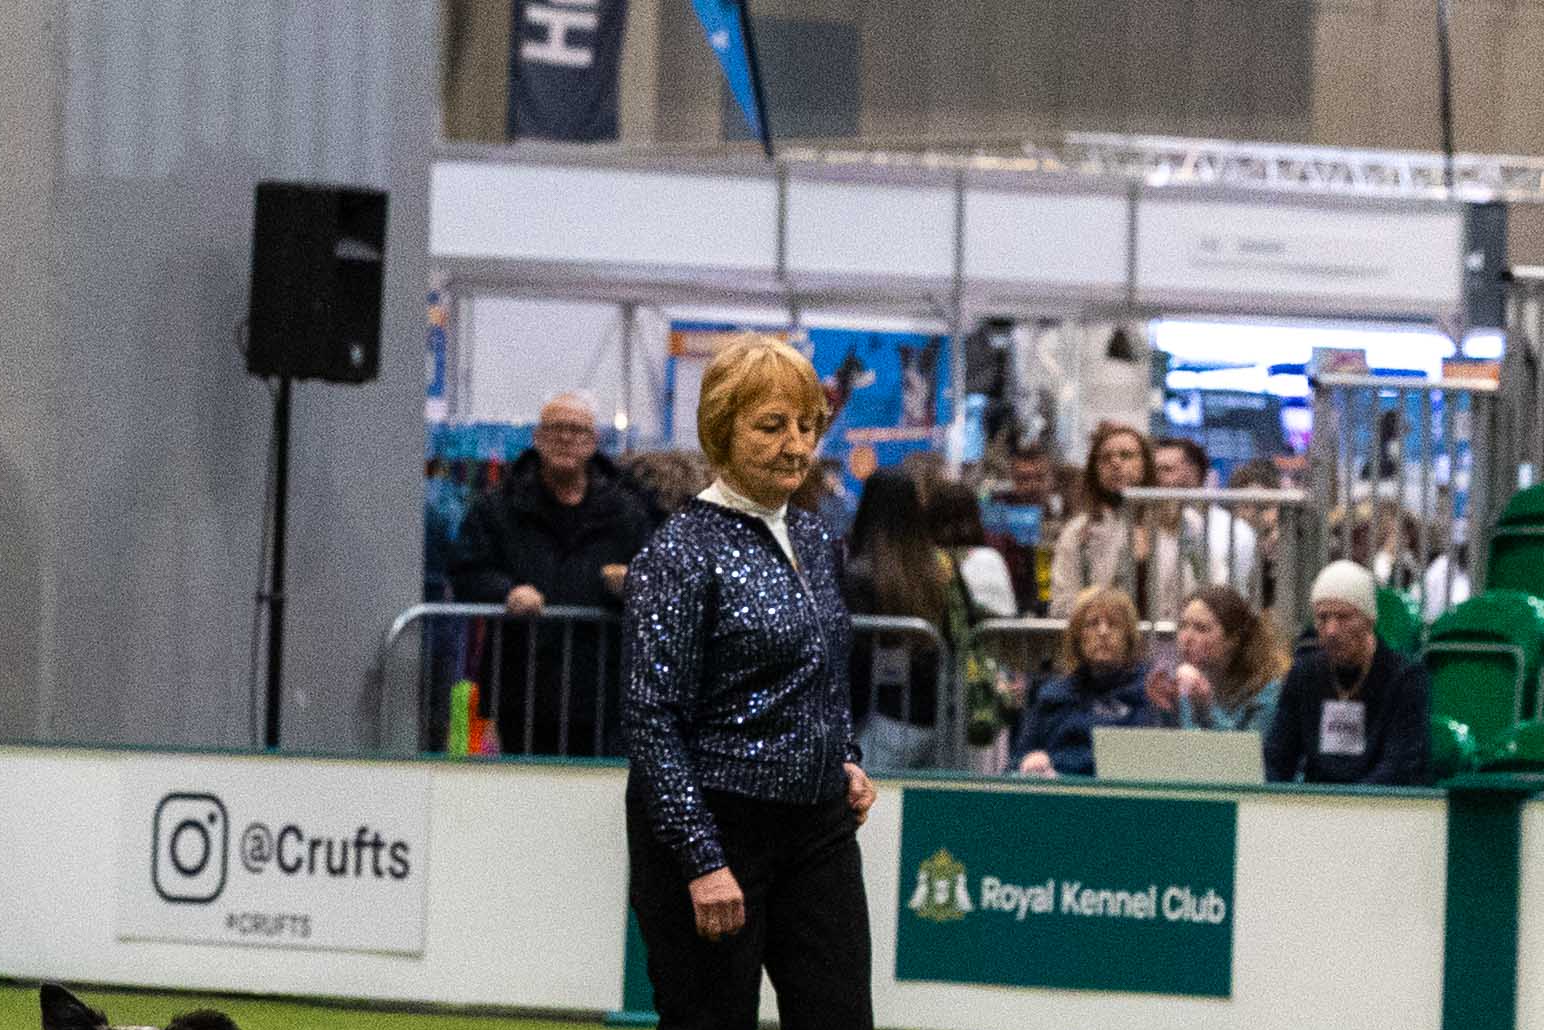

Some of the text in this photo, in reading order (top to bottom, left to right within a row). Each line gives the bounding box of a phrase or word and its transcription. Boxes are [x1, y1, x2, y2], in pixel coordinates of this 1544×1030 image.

[520, 0, 599, 66] H
[240, 822, 411, 880] @Crufts
[224, 912, 312, 939] #CRUFTS
[980, 876, 1226, 924] Royal Kennel Club
